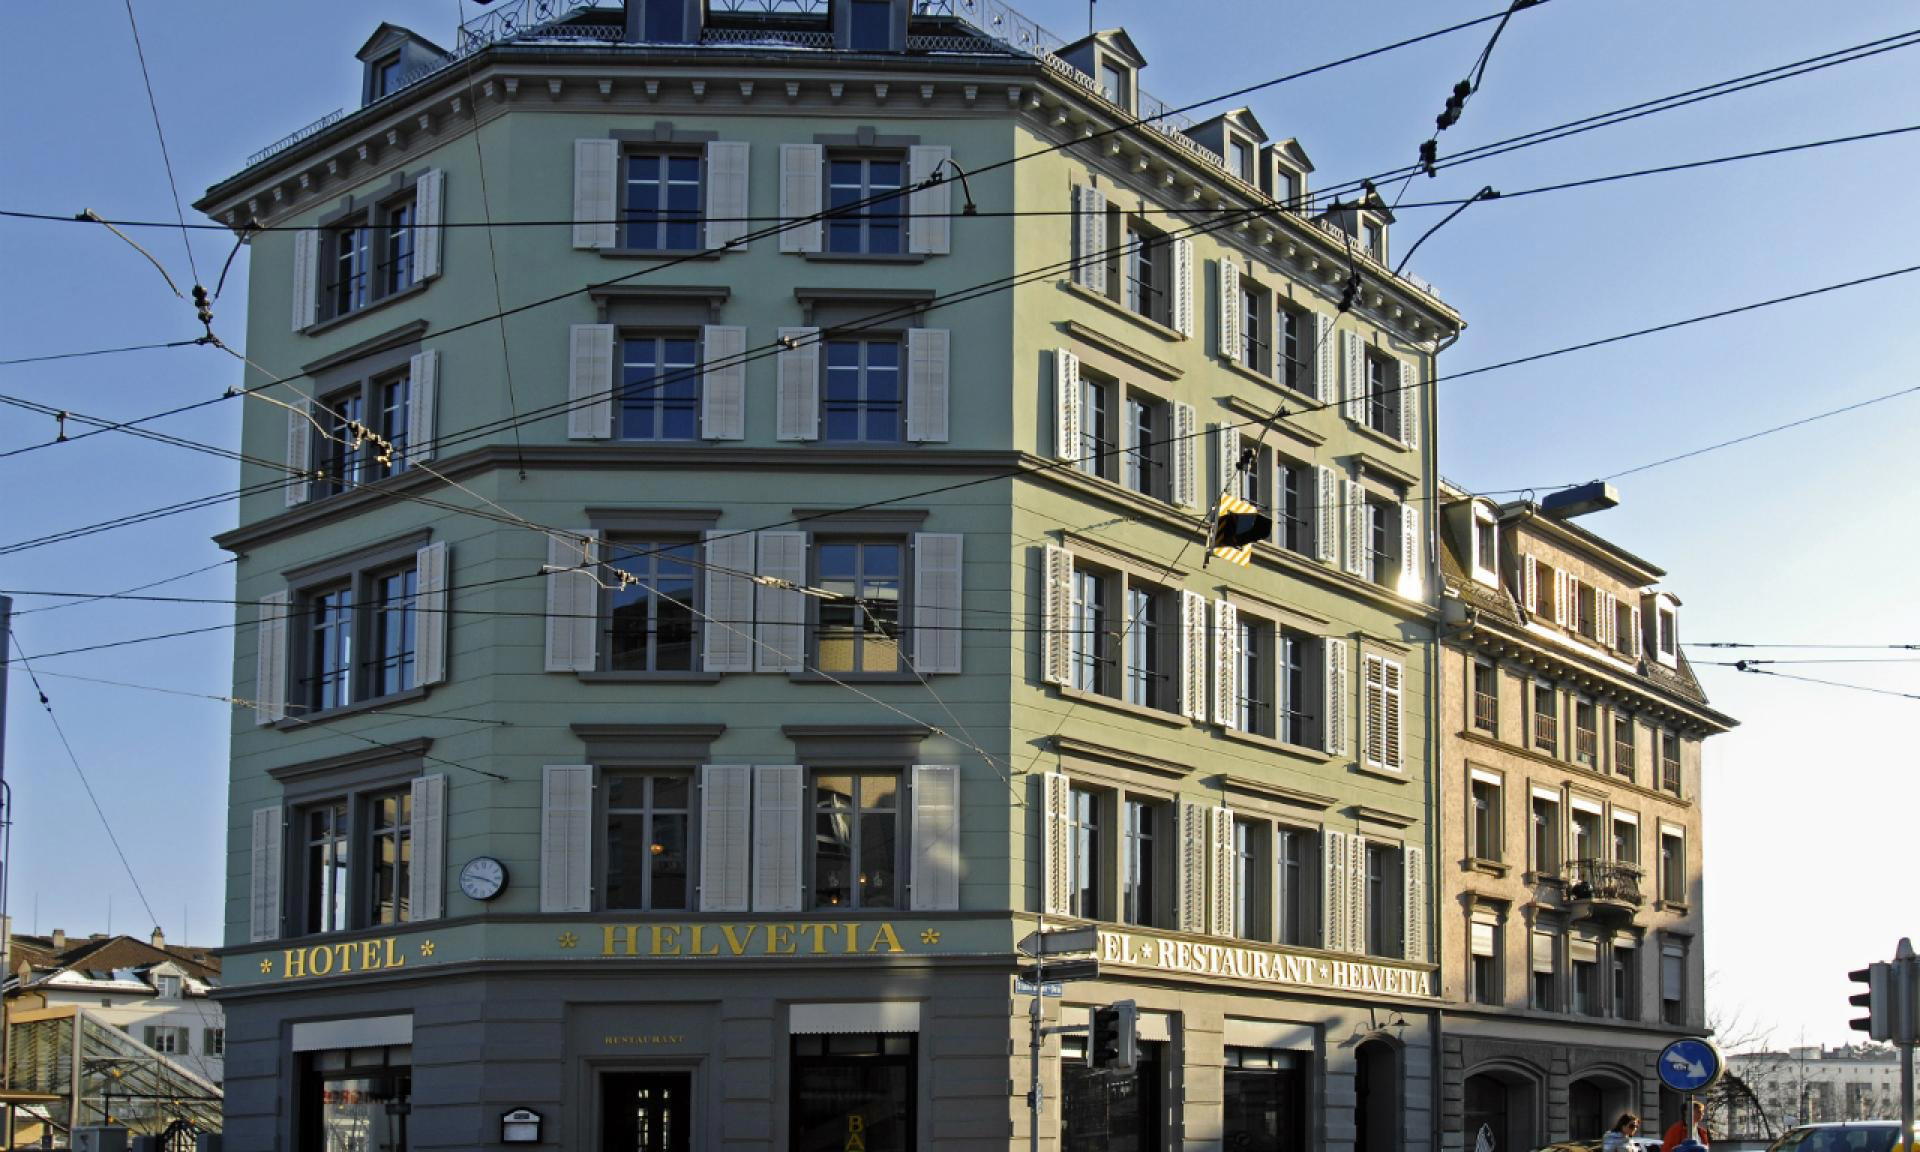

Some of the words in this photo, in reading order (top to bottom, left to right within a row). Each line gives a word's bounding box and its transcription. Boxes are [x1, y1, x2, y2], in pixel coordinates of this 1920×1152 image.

[284, 937, 405, 976] HOTEL
[603, 922, 904, 955] HELVETIA
[1097, 931, 1138, 964] EL
[1157, 938, 1315, 985] RESTAURANT
[1331, 961, 1431, 995] HELVETIA
[605, 1034, 684, 1046] RESTAURANT
[846, 1115, 865, 1152] BA
